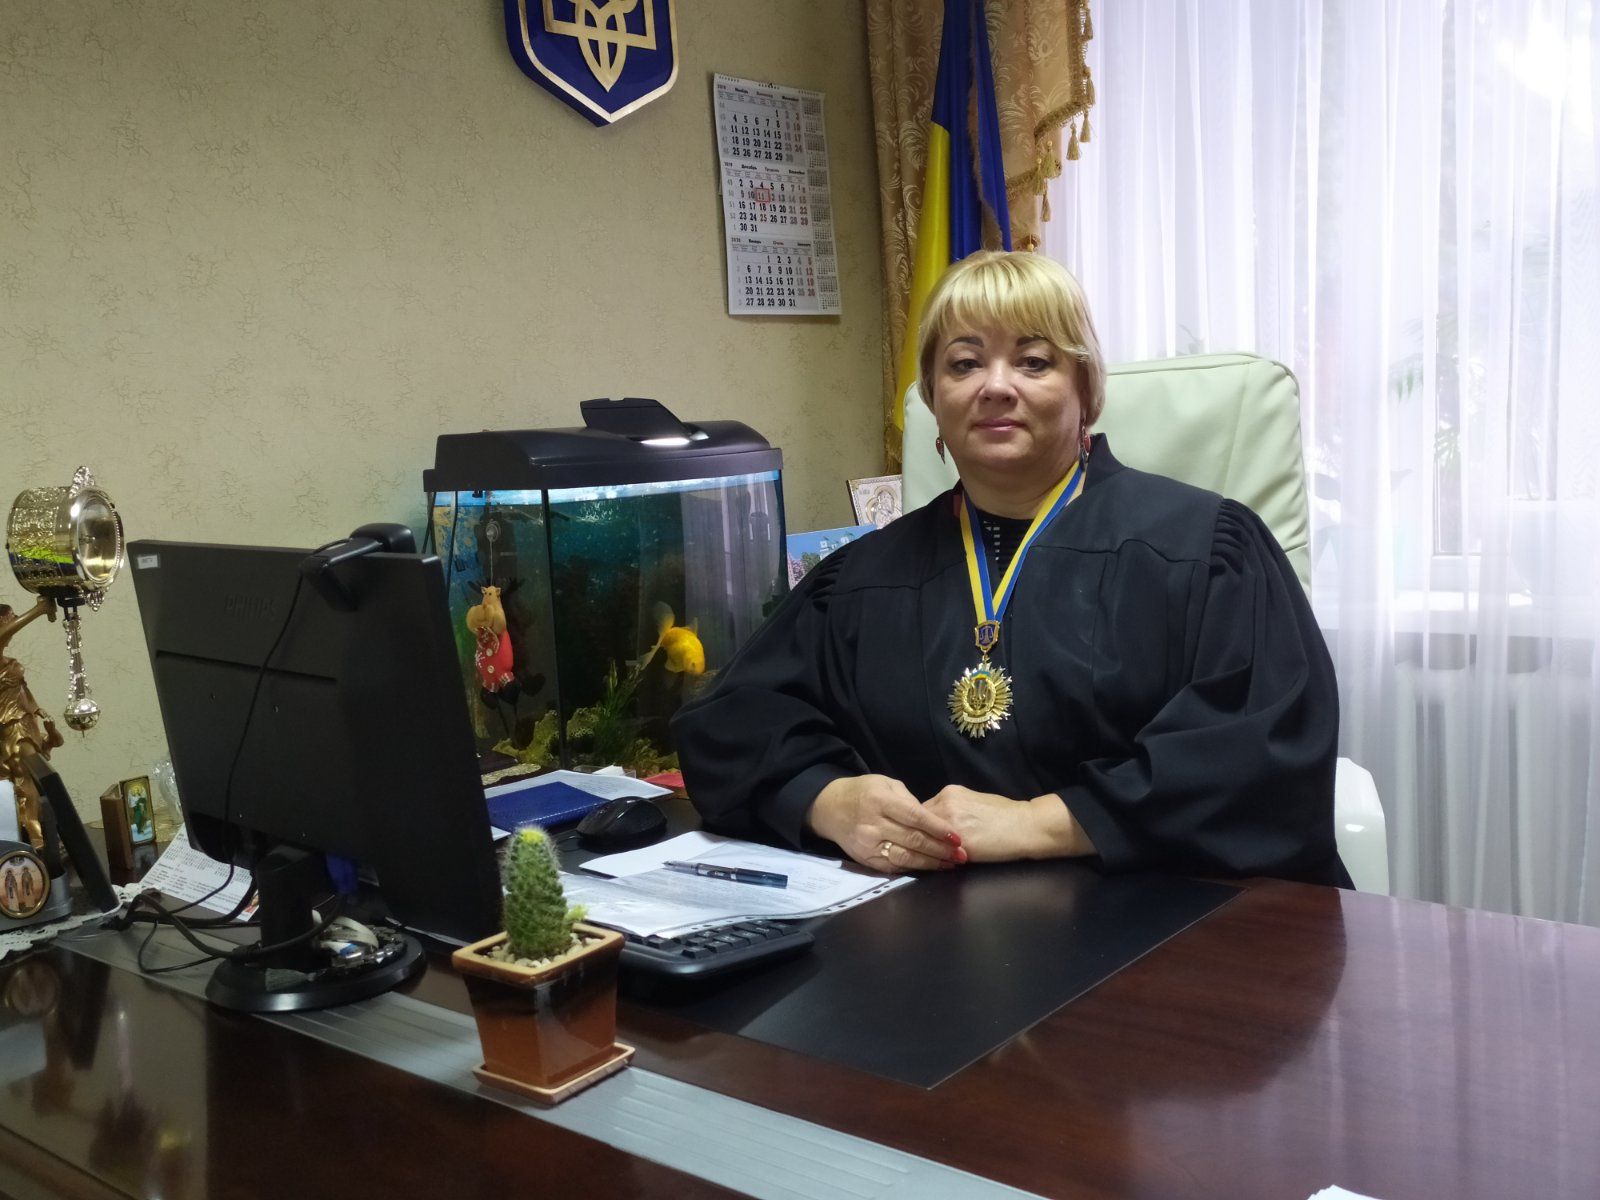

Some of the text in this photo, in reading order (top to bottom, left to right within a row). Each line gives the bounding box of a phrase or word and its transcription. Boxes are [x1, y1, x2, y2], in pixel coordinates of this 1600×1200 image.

[731, 125, 738, 133] 11
[732, 136, 739, 144] 18
[743, 149, 751, 157] 26
[739, 212, 747, 220] 23
